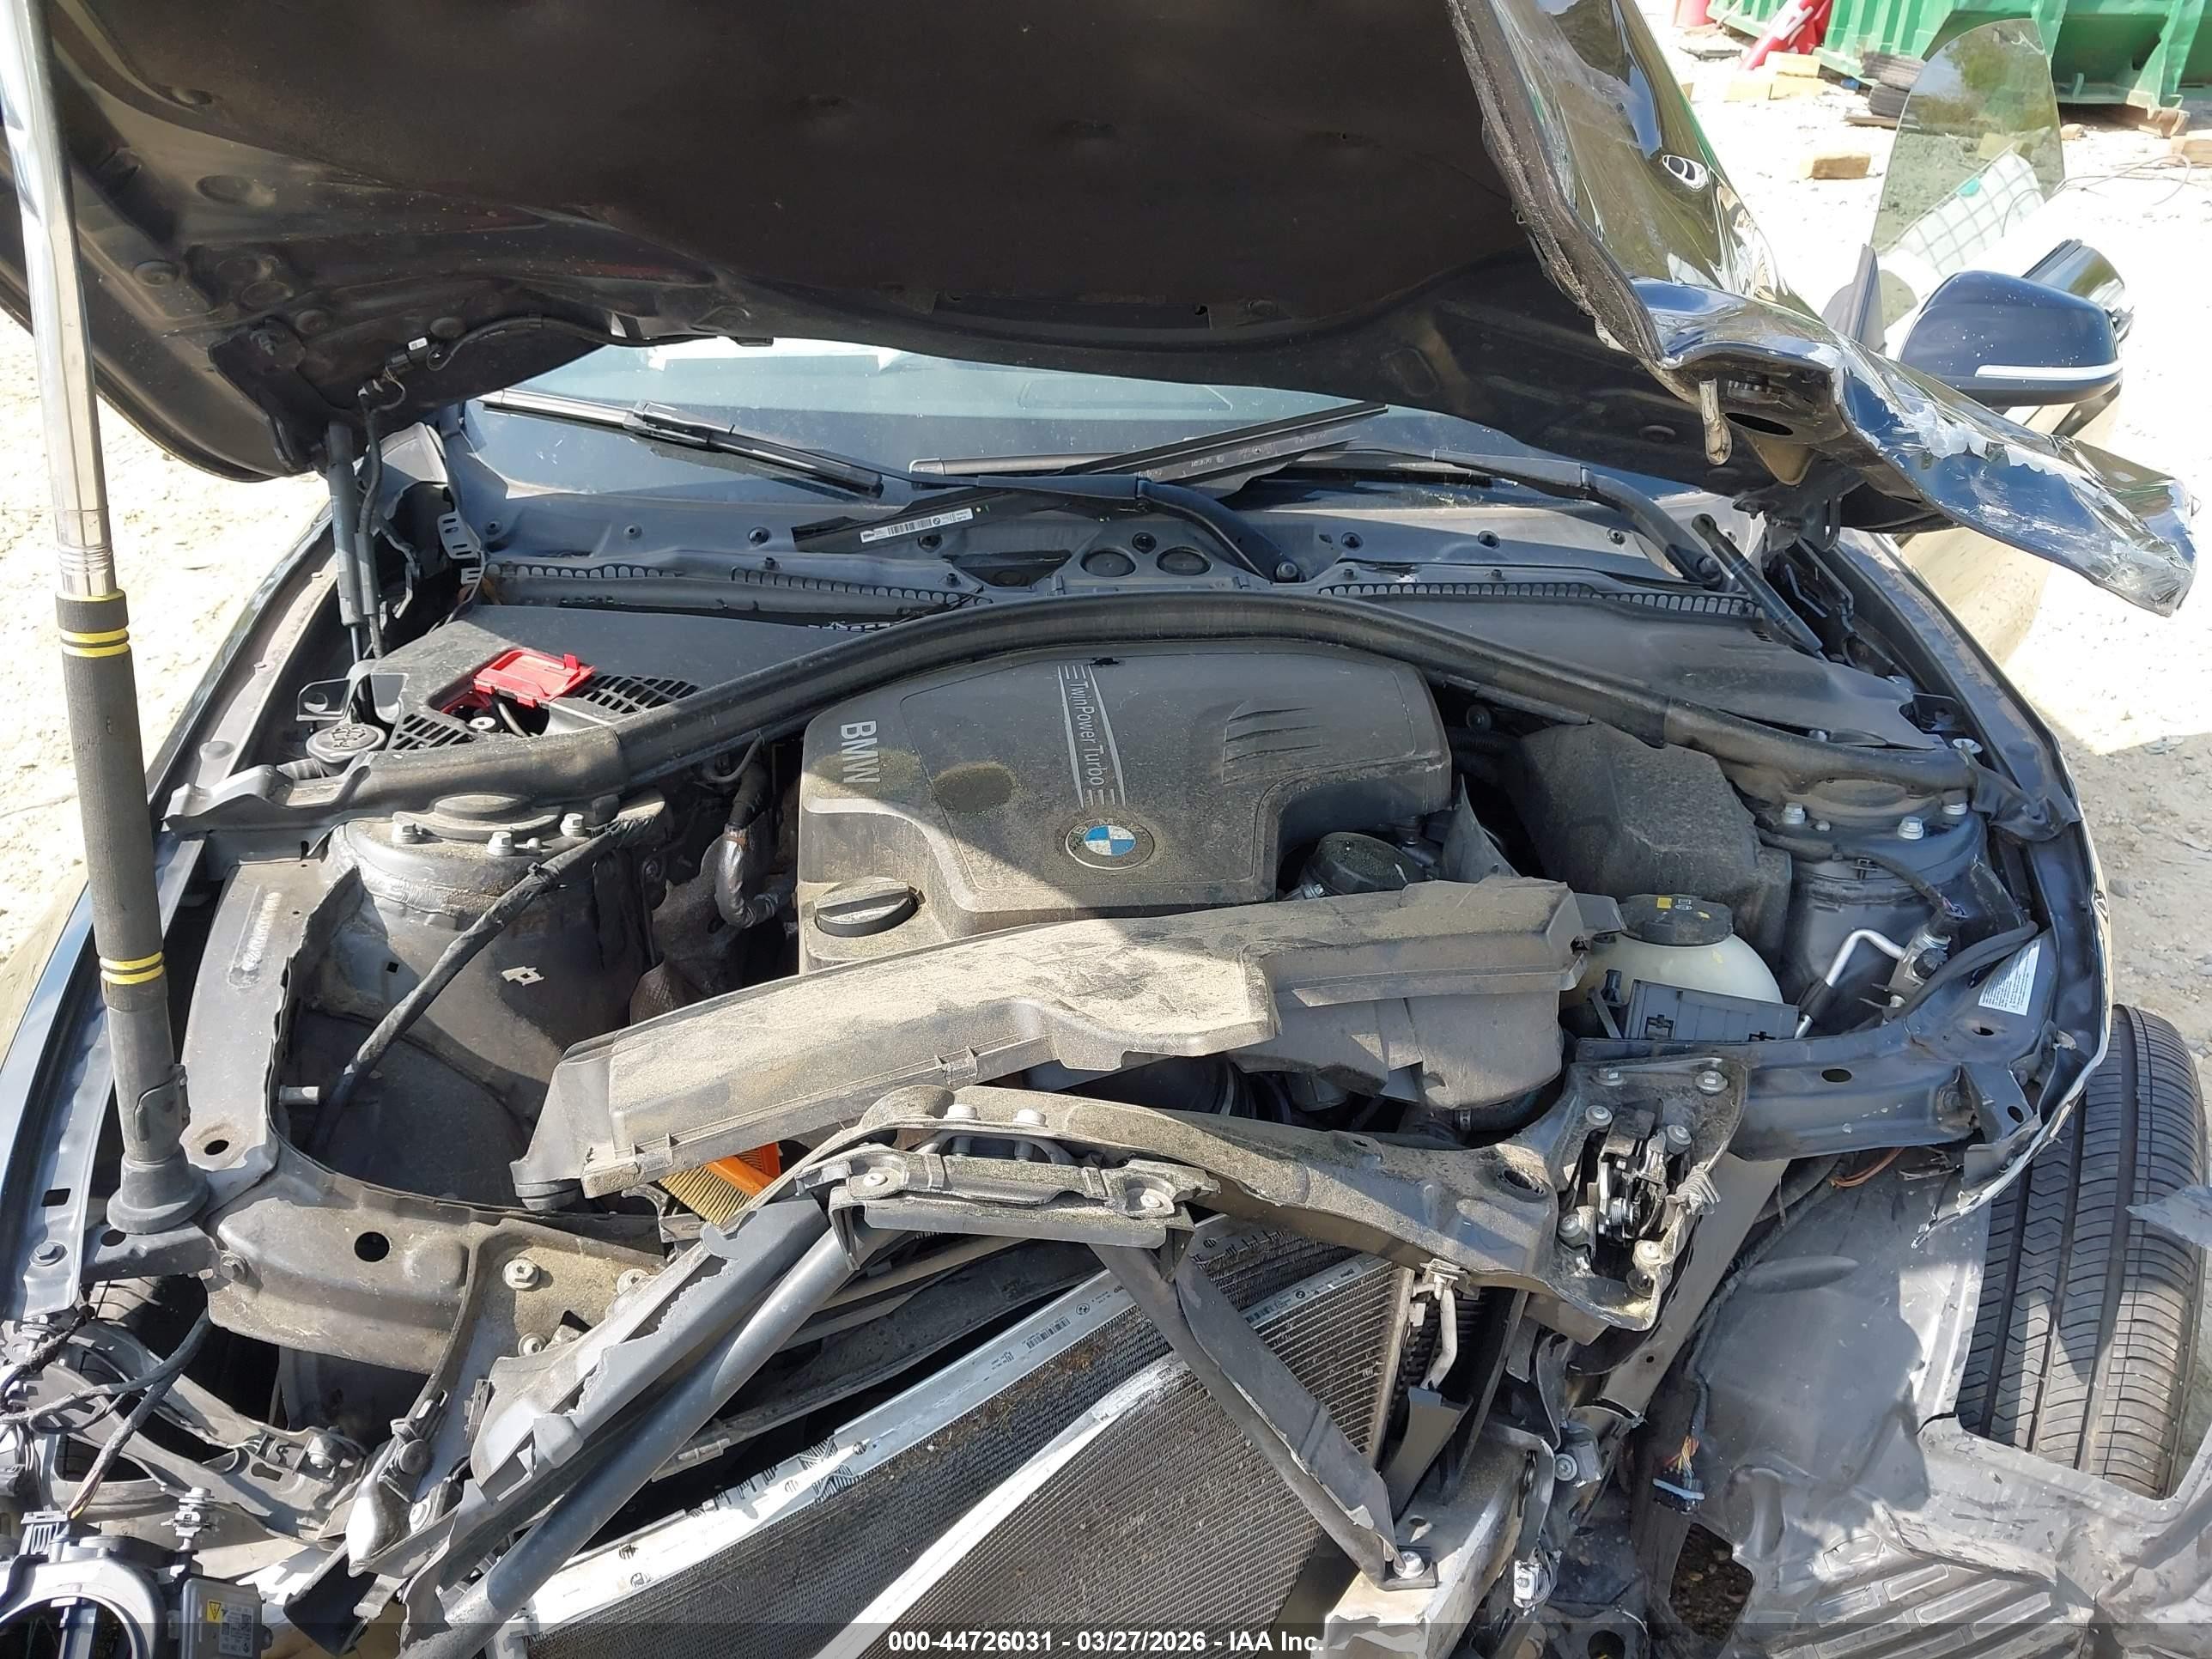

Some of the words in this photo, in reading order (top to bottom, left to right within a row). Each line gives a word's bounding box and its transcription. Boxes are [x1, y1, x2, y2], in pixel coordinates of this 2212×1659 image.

[1070, 681, 1097, 744] TwinPower
[841, 720, 881, 784] BMW
[1083, 744, 1107, 786] Turbo
